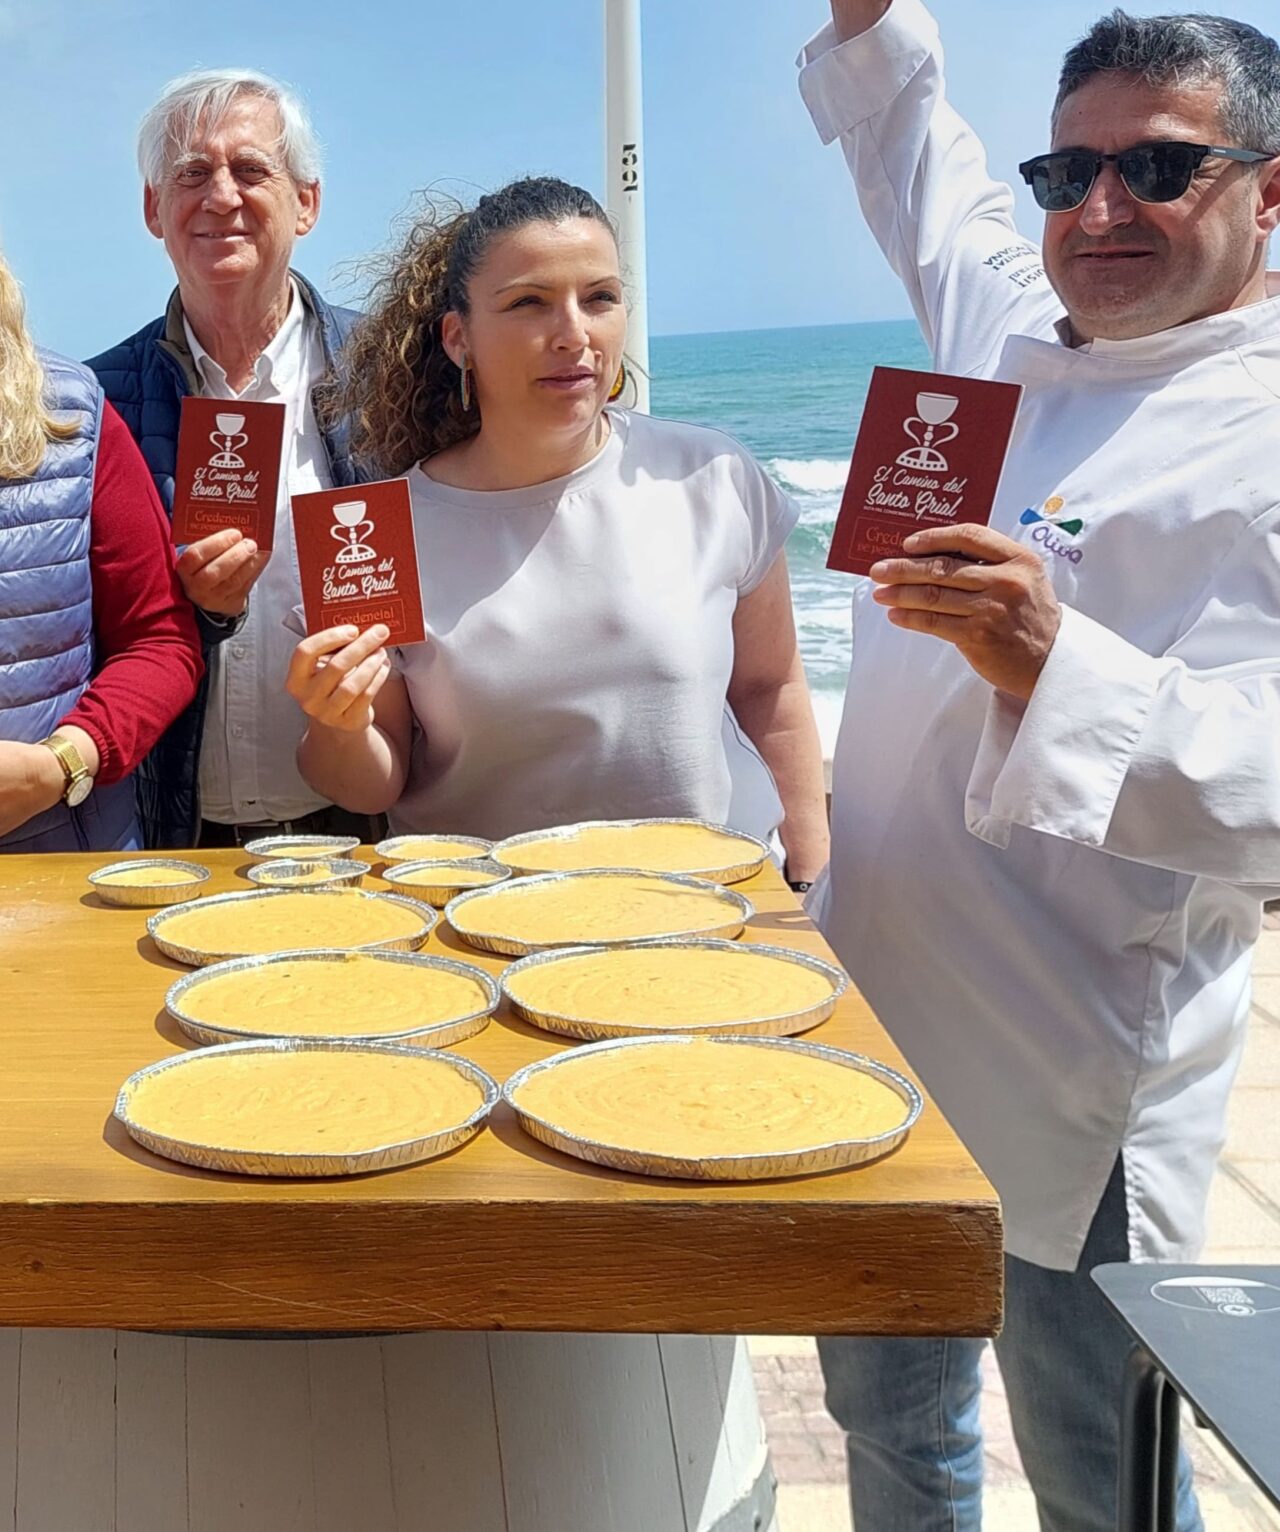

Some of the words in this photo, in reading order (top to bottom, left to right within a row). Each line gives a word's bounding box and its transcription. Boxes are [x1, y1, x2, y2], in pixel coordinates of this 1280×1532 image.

[194, 467, 205, 479] El
[207, 468, 241, 482] Camino
[243, 470, 260, 483] del
[873, 465, 890, 484] El
[892, 468, 941, 491] Camino
[943, 476, 968, 495] del
[190, 480, 222, 498] Santo
[226, 481, 259, 504] Grial
[865, 483, 911, 510] Santo
[915, 489, 964, 521] Grial
[195, 511, 251, 525] Credencial
[1031, 526, 1084, 565] Oliva
[322, 566, 336, 583] El
[338, 563, 374, 580] Camino
[376, 557, 394, 573] del
[322, 580, 359, 602] Santo
[361, 570, 396, 600] Grial
[332, 605, 394, 627] Credencial
